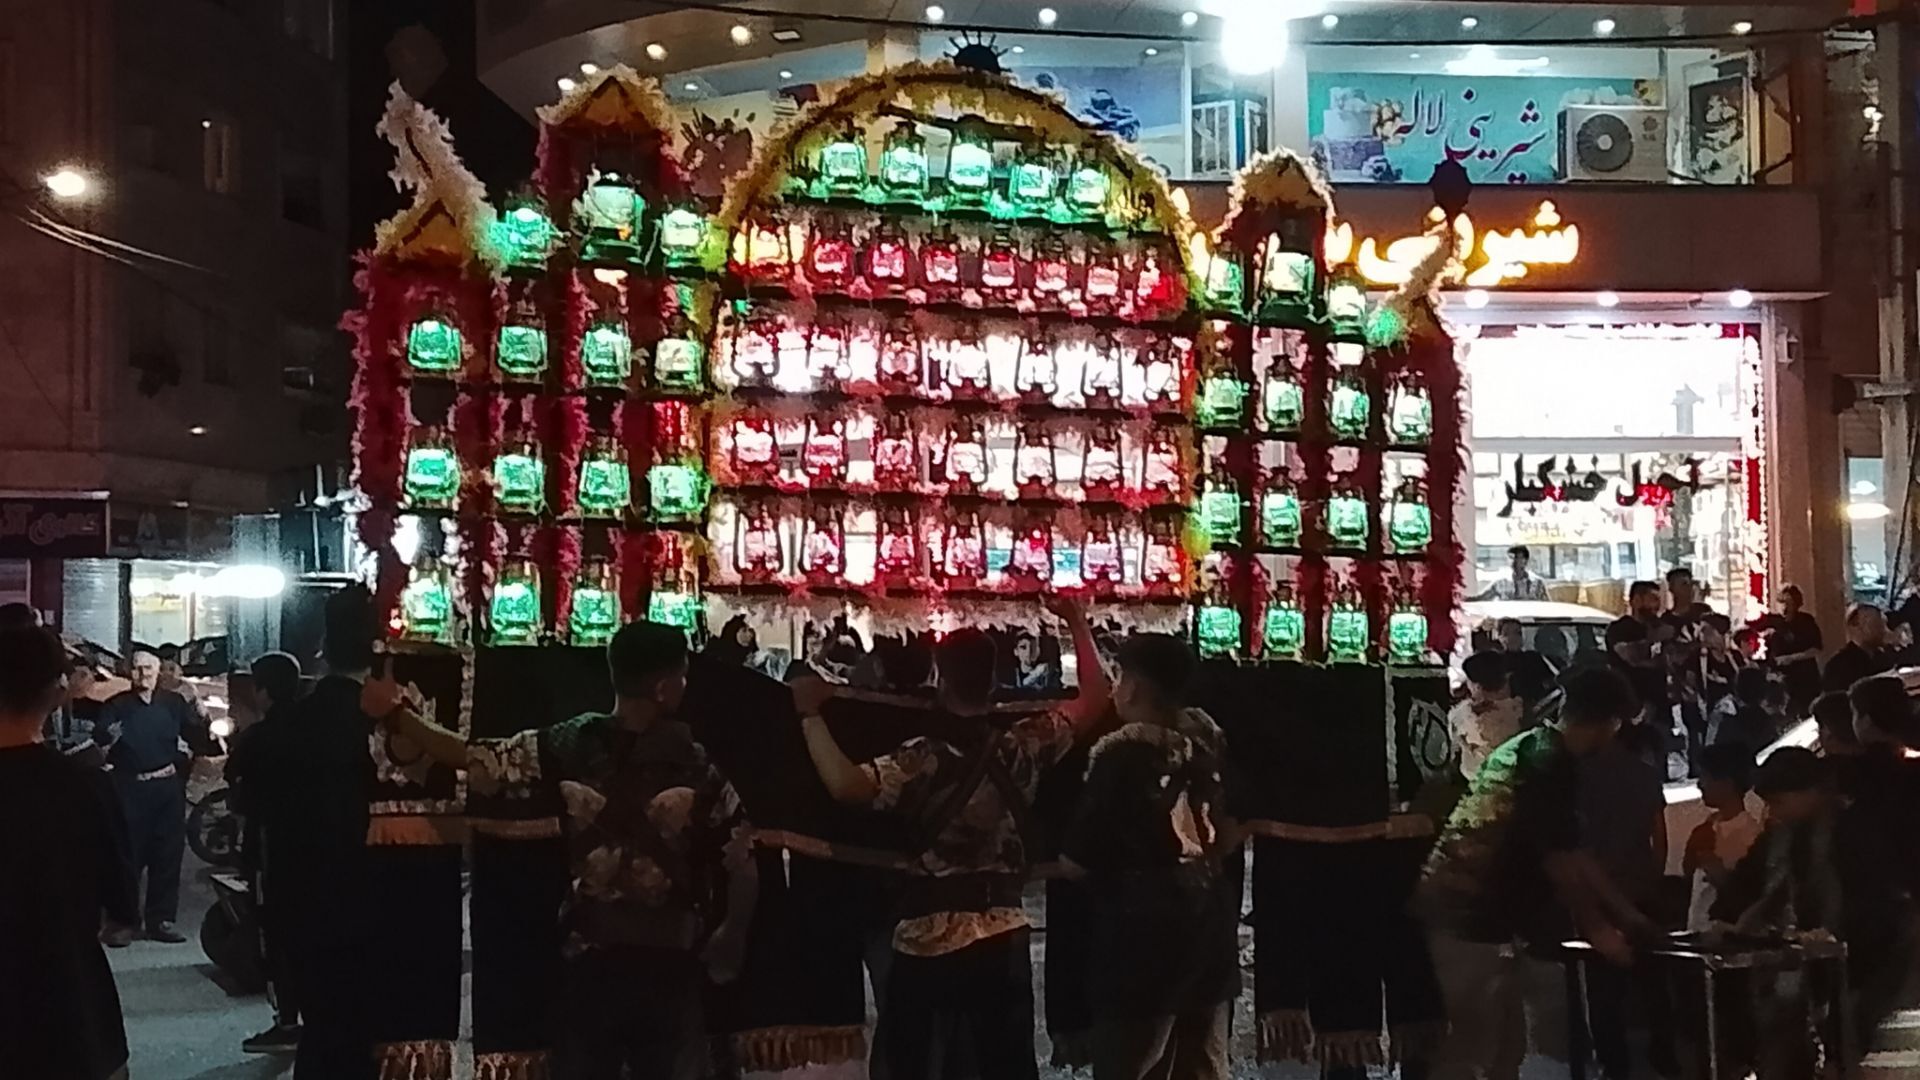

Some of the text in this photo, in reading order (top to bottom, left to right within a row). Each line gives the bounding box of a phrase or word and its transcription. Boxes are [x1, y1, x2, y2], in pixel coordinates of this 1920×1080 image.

[1392, 88, 1549, 184] شیرینی لاله
[1496, 453, 1608, 518] خشکبار
